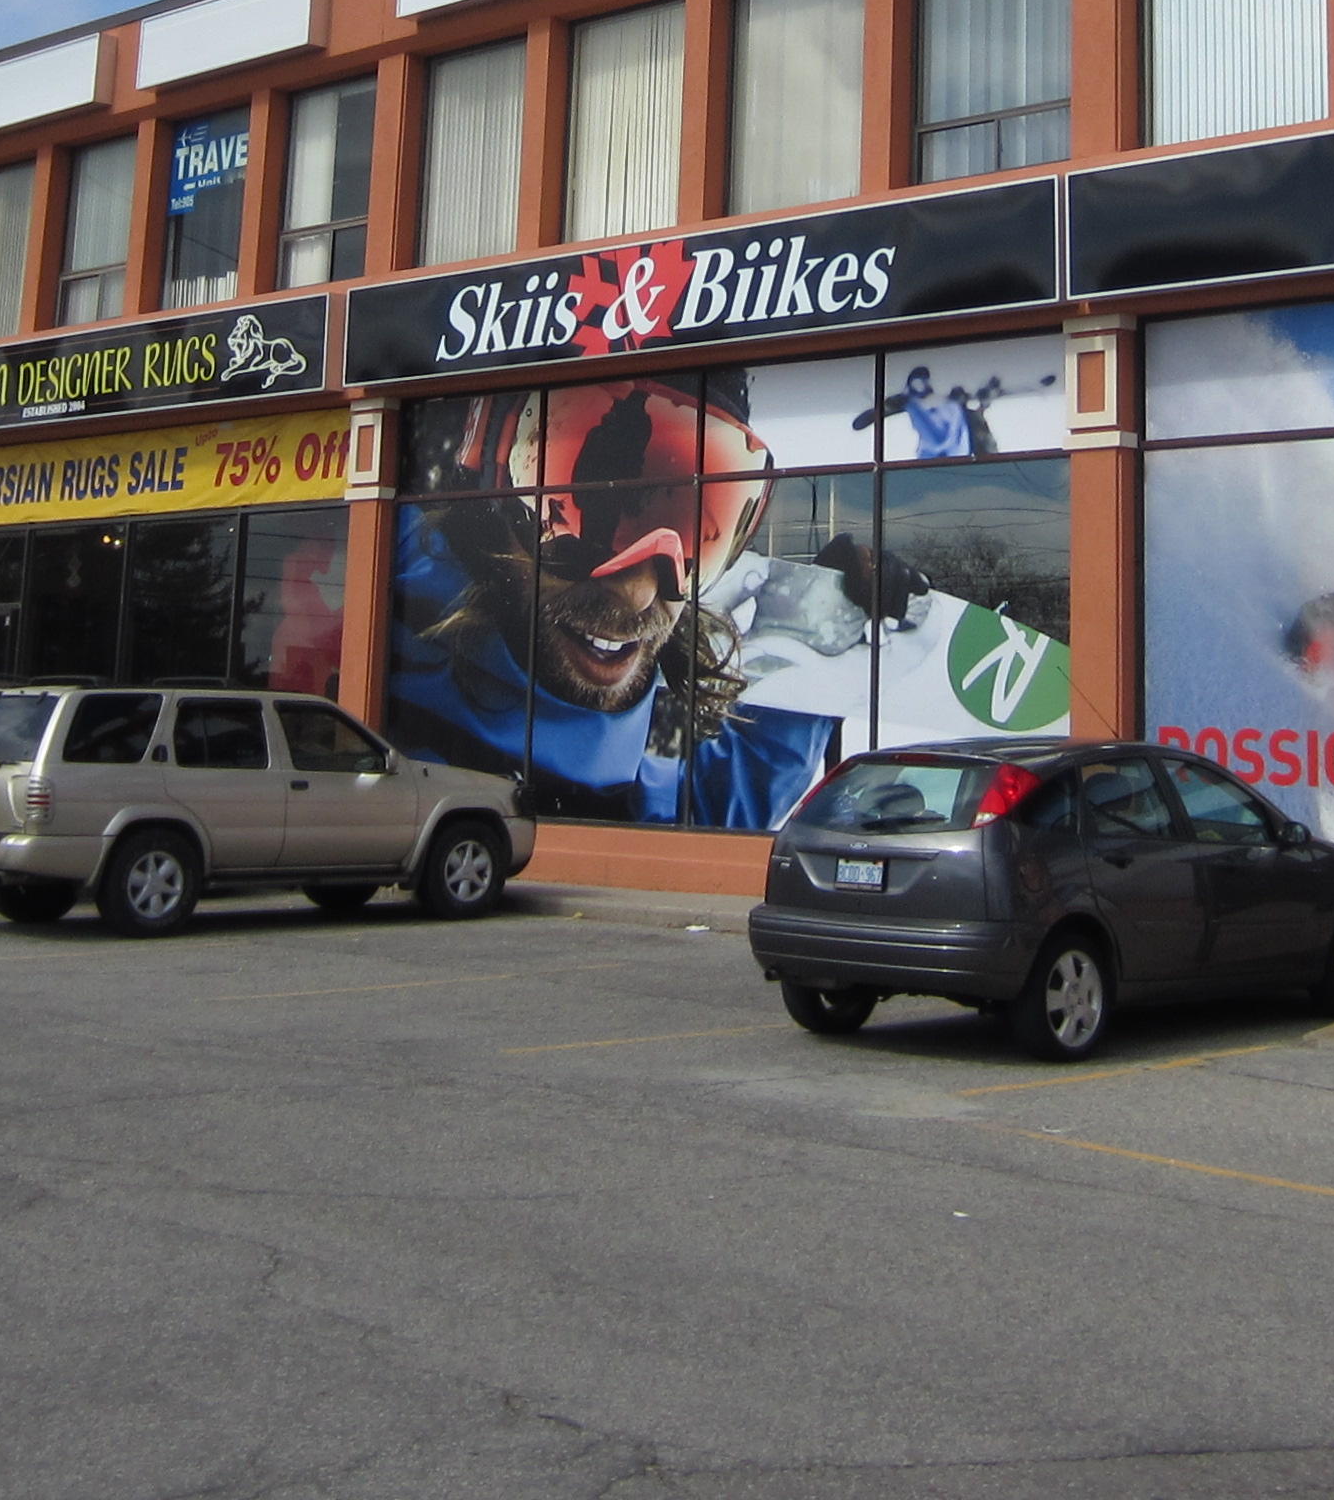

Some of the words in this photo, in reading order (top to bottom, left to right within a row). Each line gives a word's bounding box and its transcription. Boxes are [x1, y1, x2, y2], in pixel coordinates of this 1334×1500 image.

[175, 132, 249, 180] TRAVE
[436, 272, 583, 362] Skiis
[602, 257, 666, 340] &
[673, 234, 896, 331] Biikes
[17, 346, 133, 406] DESIGNER
[143, 333, 217, 388] RUGS
[60, 454, 120, 501] RUGS
[127, 446, 189, 495] SALE
[214, 435, 281, 487] 75%
[295, 428, 350, 481] Off
